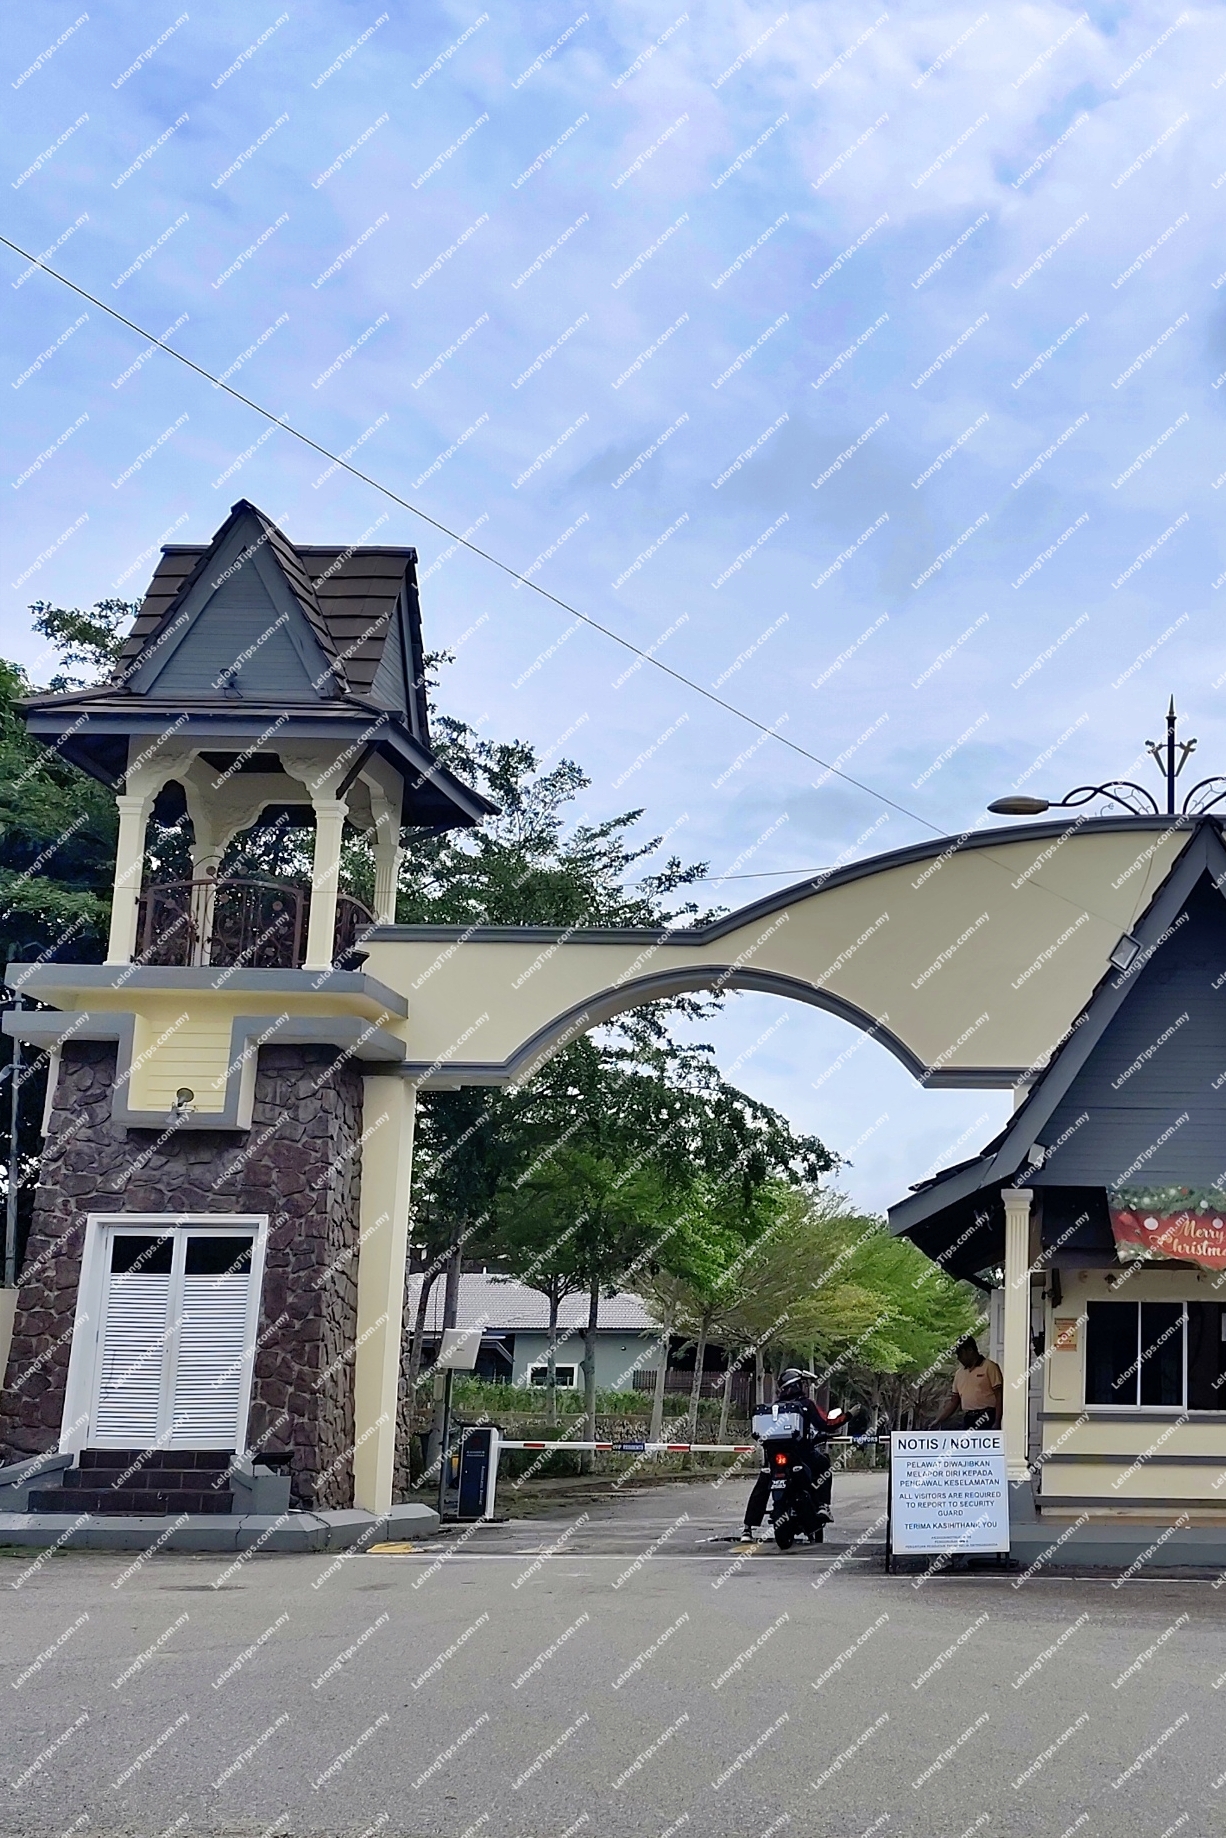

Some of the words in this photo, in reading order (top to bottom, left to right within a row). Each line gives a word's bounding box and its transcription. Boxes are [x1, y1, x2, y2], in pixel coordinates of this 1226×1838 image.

[1176, 1219, 1226, 1243] Merry
[898, 1438, 939, 1450] NOTIS
[950, 1437, 1001, 1449] NOTICE
[943, 1460, 990, 1468] DIWAJIBKAN
[962, 1469, 993, 1477] KEPADA
[944, 1478, 1000, 1486] KESELAMATAN
[914, 1492, 947, 1500] VISITORS
[964, 1491, 1001, 1499] REQUIRED
[959, 1500, 995, 1508] SECURITY
[937, 1509, 964, 1517] GUARD
